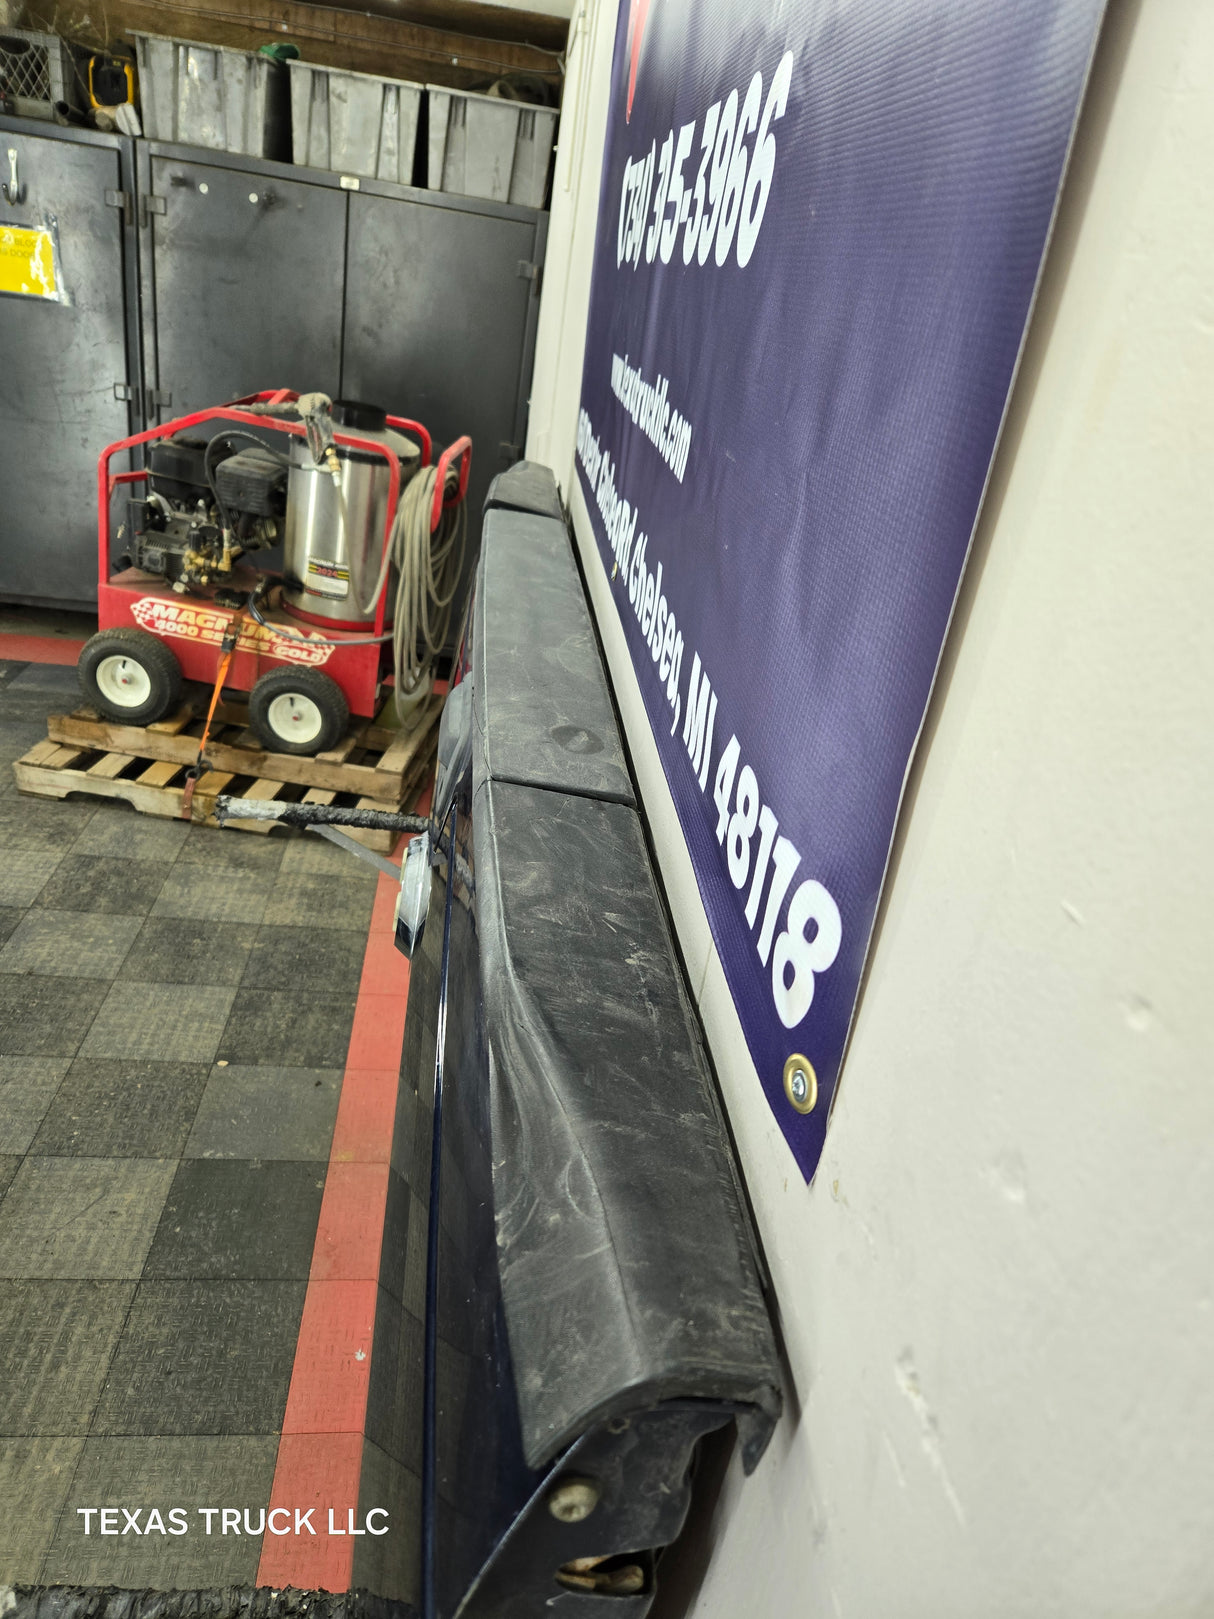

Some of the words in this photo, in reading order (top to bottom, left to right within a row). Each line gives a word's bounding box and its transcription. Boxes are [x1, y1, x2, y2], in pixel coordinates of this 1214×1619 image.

[645, 50, 793, 268] 315-3966
[151, 604, 276, 641] MAGNUM
[155, 618, 199, 637] 4000
[201, 629, 271, 651] SEIES
[276, 646, 321, 662] GOLD
[629, 531, 684, 737] Chelsea,
[683, 651, 718, 793] MI
[713, 734, 842, 1029] 48118
